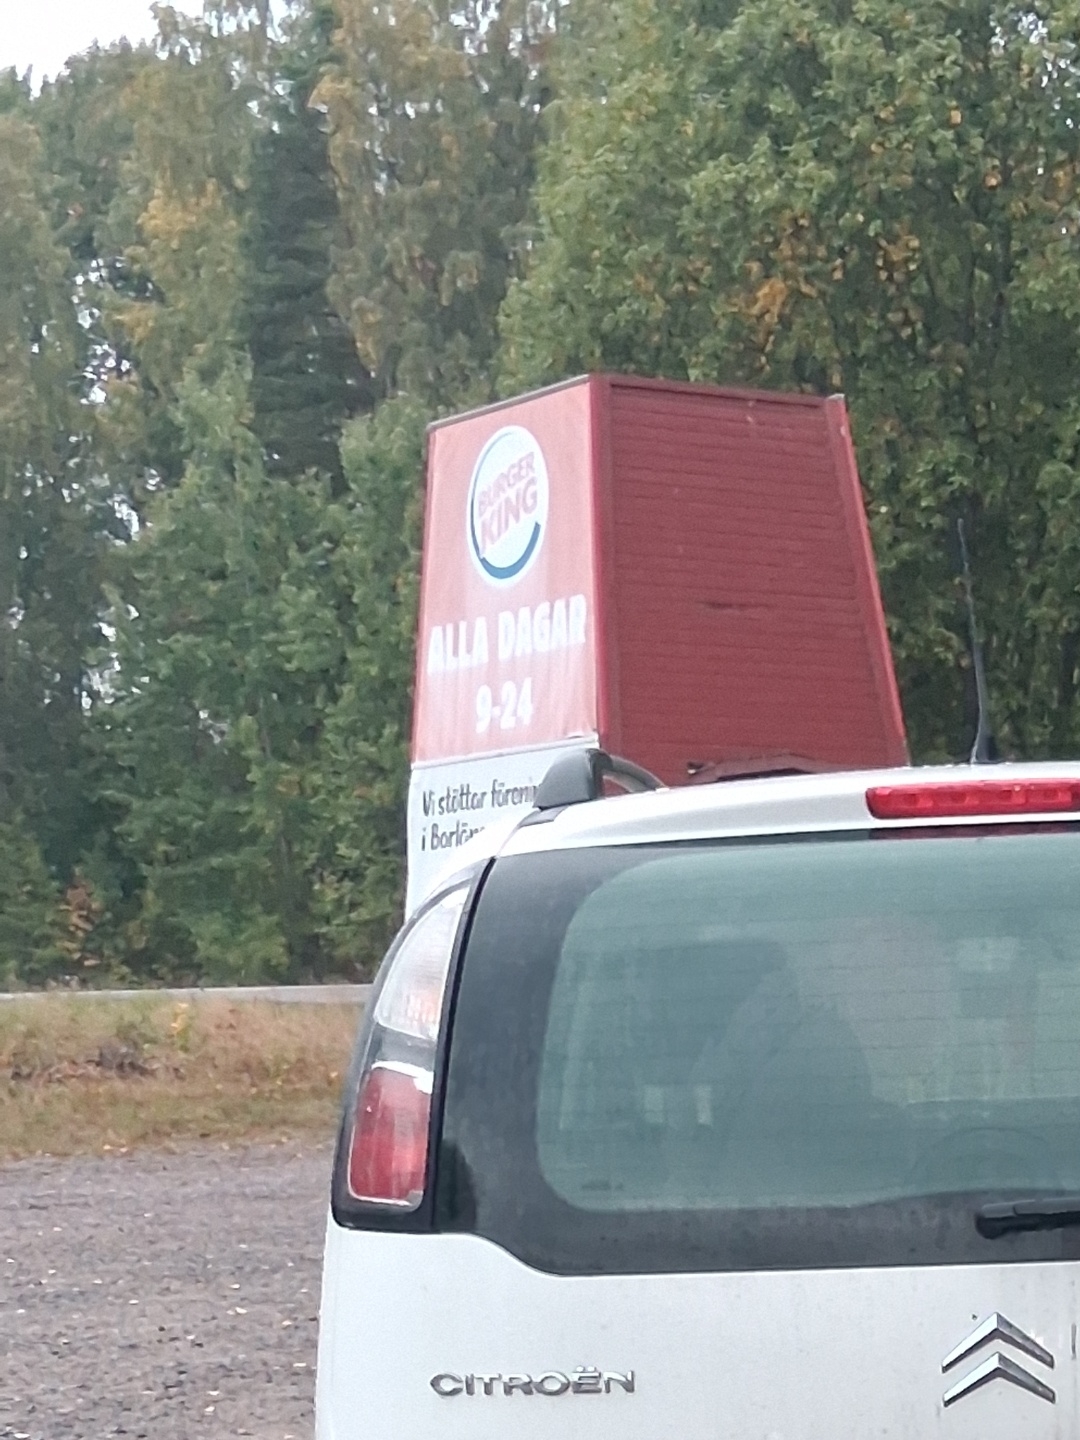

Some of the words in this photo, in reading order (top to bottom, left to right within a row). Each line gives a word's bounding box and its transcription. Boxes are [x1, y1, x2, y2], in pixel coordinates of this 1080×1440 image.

[478, 451, 535, 517] BURGER
[480, 477, 537, 552] KING
[428, 616, 488, 673] ALLA
[498, 594, 586, 659] DAGAR
[475, 677, 534, 733] 9-24
[422, 790, 435, 817] Vi
[438, 784, 487, 815] stöttar
[421, 827, 427, 851] i
[429, 1365, 635, 1397] CITROËN
